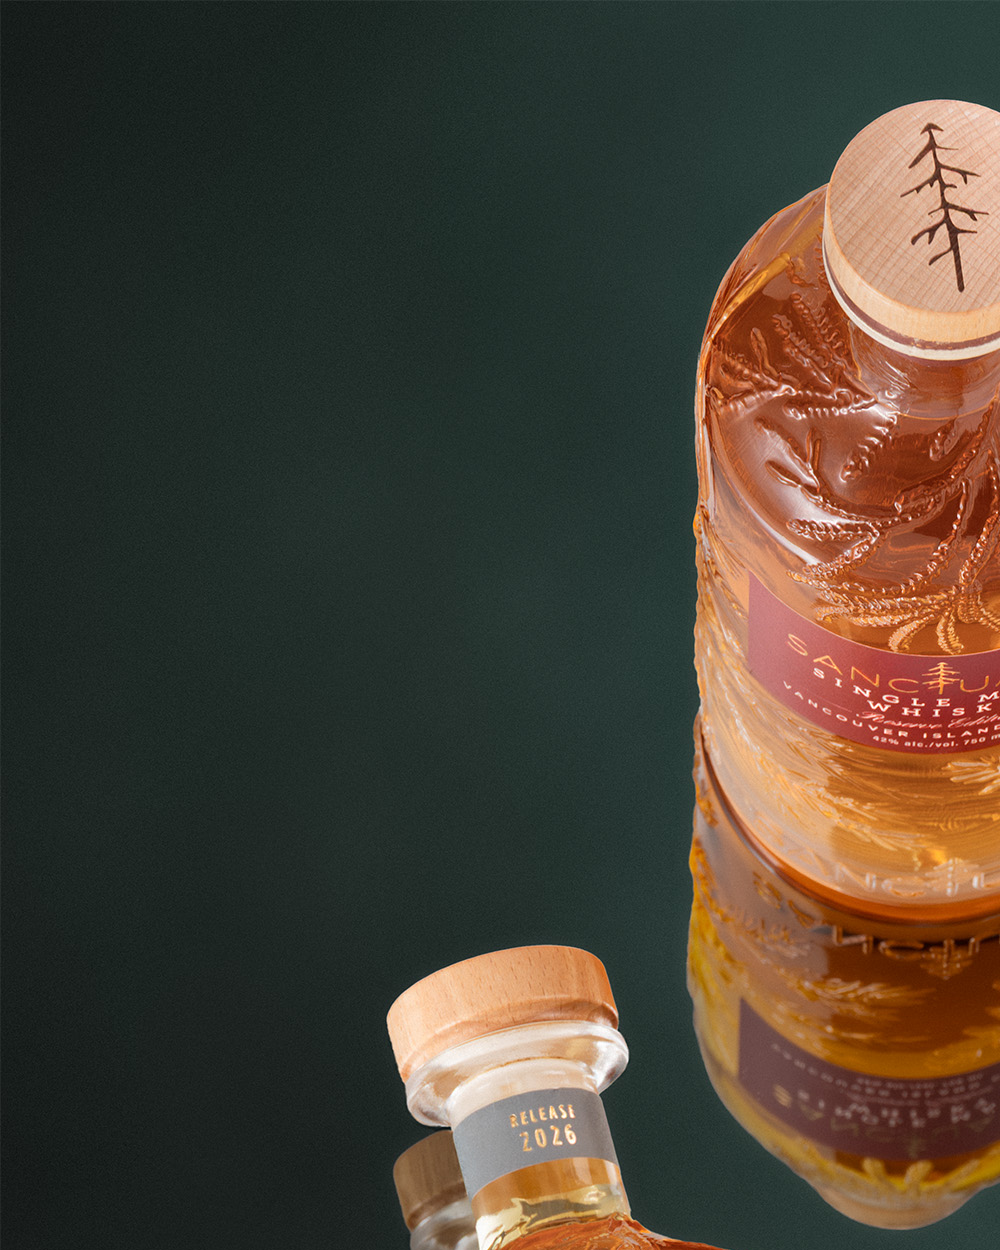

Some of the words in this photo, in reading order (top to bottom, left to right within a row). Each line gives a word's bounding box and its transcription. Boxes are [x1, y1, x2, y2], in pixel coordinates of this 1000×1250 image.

[813, 667, 951, 707] SINGLE
[782, 680, 909, 738] VANCOUVER
[872, 735, 900, 746] 42%
[904, 738, 959, 749] alc./vol.
[963, 736, 987, 747] 750
[509, 1103, 577, 1128] RELEASE
[519, 1123, 578, 1152] 2026
